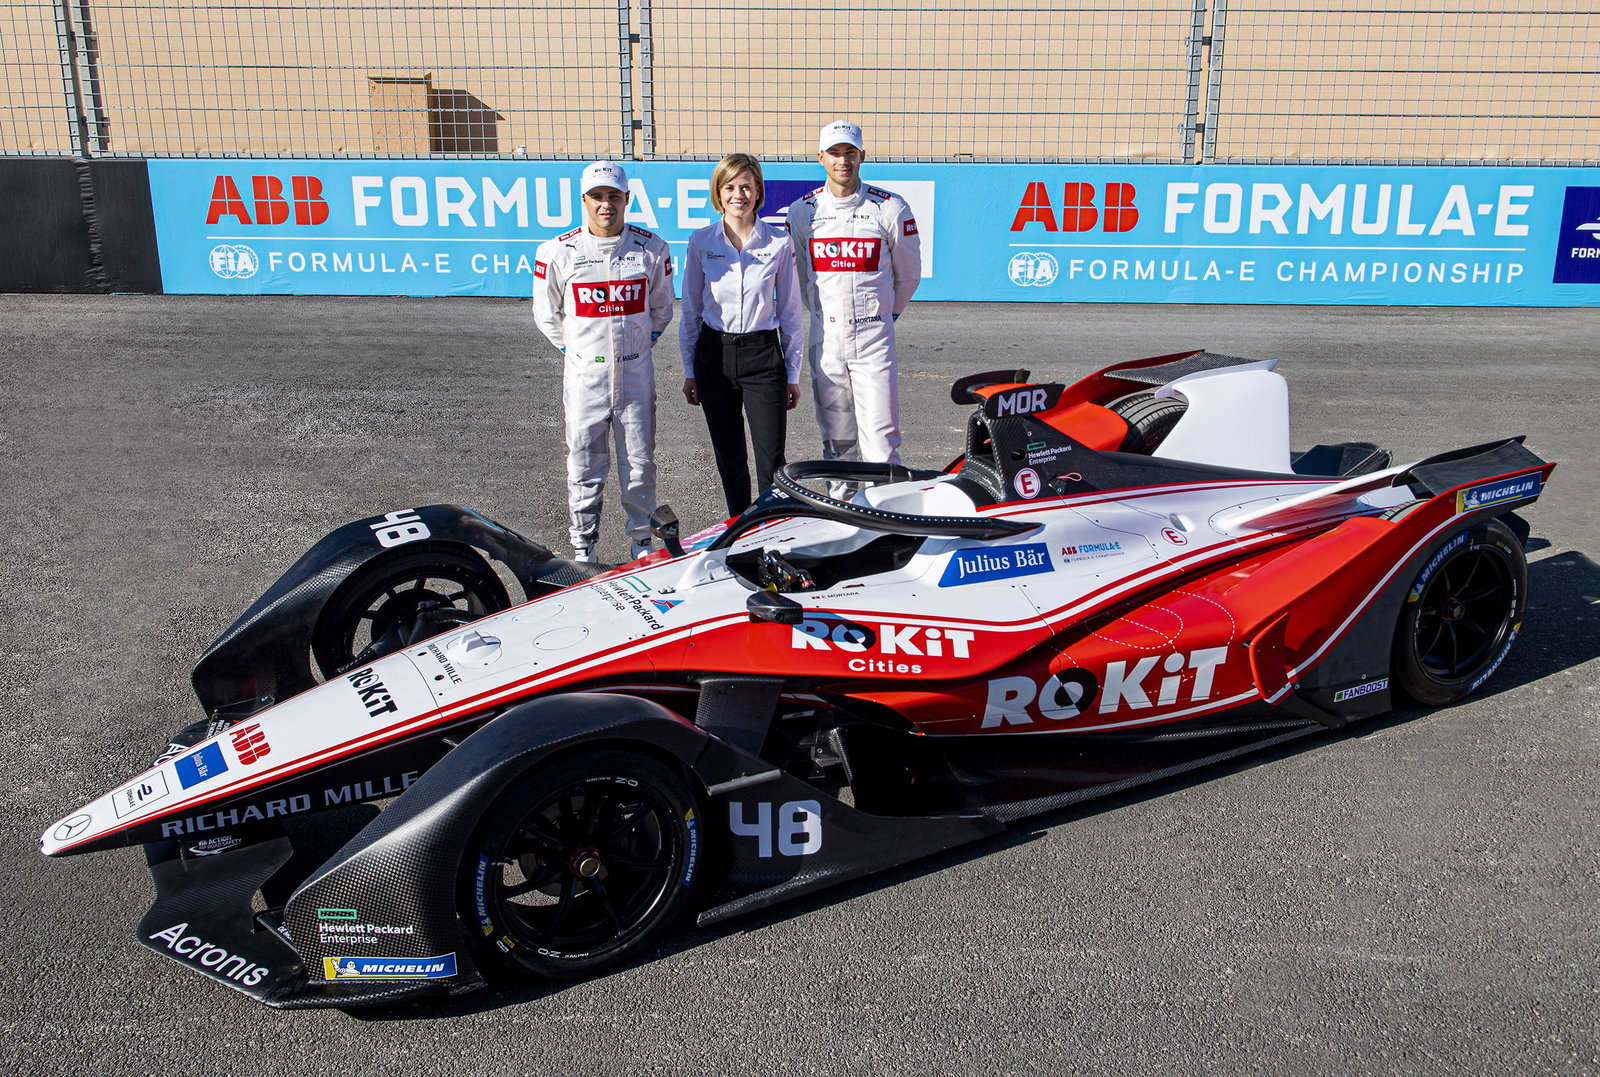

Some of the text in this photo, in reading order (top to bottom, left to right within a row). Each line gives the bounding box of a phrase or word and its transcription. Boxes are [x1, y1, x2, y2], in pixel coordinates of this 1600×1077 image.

[205, 175, 330, 226] ABB
[1009, 181, 1535, 238] ABB FORMULA-E
[268, 251, 451, 274] FORMULA-E
[830, 259, 856, 268] Cities
[1069, 258, 1525, 285] FORMULA-E CHAMPIONSHIP
[598, 304, 625, 313] Cities
[997, 388, 1048, 418] MOR
[1028, 444, 1072, 460] Hewlett Packard
[1028, 454, 1057, 466] Enterprise
[1019, 473, 1035, 495] E
[1480, 480, 1534, 502] MICHELIN
[369, 508, 432, 549] 48
[957, 548, 1045, 579] Julius Bär
[1061, 545, 1078, 556] ABB
[1420, 534, 1465, 582] MICHELIN
[628, 598, 665, 632] Packard
[426, 643, 463, 686] RICHARD MILLE
[847, 658, 923, 675] Cities
[1343, 679, 1388, 700] FANBOOST
[229, 722, 272, 767] ABB
[160, 793, 311, 839] RICHARD
[729, 799, 823, 858] 48
[208, 835, 232, 845] ACTION
[685, 827, 697, 883] MICHELIN
[475, 859, 487, 916] MICHELIN
[318, 922, 414, 936] Hewlett Packard
[319, 933, 378, 946] Enterprise
[148, 921, 270, 987] Acronis
[361, 962, 445, 974] MICHELIN
